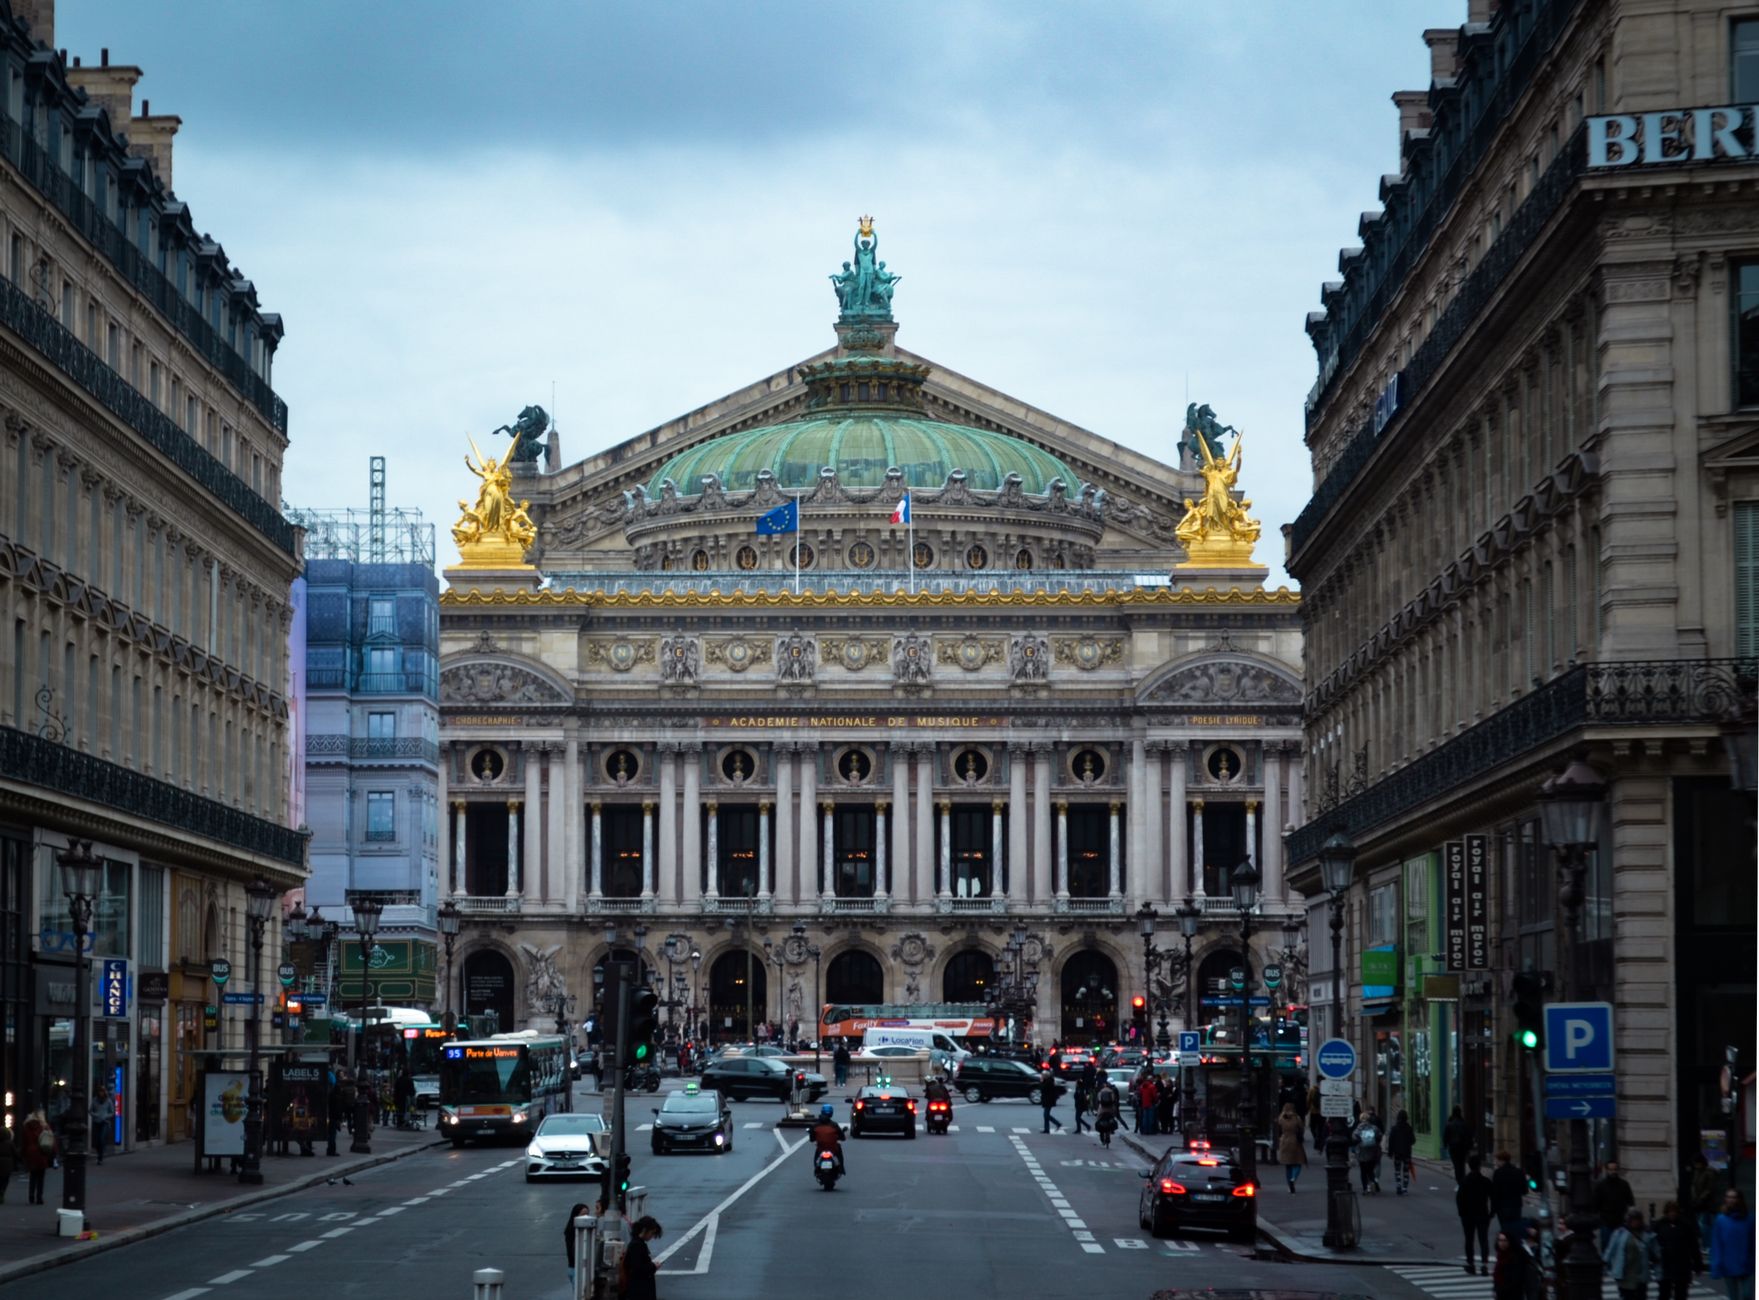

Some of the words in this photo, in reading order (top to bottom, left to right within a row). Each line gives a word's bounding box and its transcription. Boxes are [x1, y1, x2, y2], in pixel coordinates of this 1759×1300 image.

[1586, 105, 1759, 168] BER
[730, 717, 798, 727] ACADEMIE
[810, 717, 876, 727] NATIONALE
[888, 717, 905, 727] DE
[917, 717, 979, 727] MUSIQUE
[1451, 847, 1461, 890] royal
[1471, 840, 1482, 885] royal
[1451, 897, 1462, 921] air
[1472, 892, 1483, 917] air
[1450, 929, 1464, 968] maroc
[1470, 925, 1485, 966] maroc
[212, 964, 229, 973] BUS
[279, 967, 294, 975] BUS
[1265, 968, 1280, 977] BUS
[108, 962, 122, 1015] CHANGE
[891, 1036, 924, 1045] Location
[1184, 1036, 1194, 1048] P
[1564, 1019, 1595, 1060] P
[448, 1049, 461, 1058] 95
[466, 1049, 484, 1058] Porte
[282, 1067, 311, 1077] LABEL
[312, 1067, 320, 1077] 5
